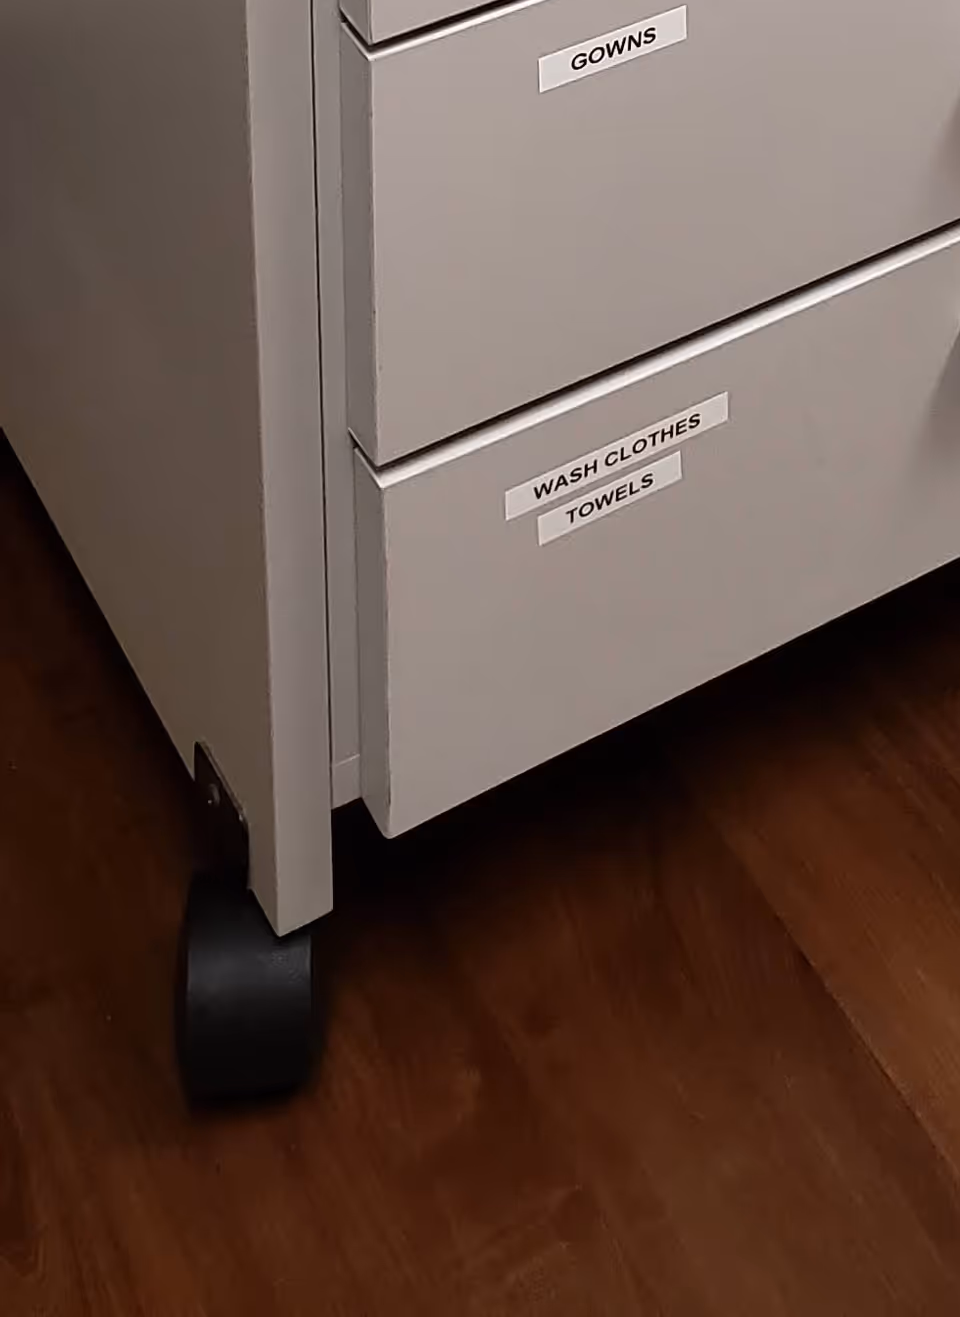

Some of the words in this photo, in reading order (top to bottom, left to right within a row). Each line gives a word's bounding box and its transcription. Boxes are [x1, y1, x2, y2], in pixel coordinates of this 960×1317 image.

[570, 26, 657, 71] GOWNS
[533, 458, 599, 500] WASH
[603, 412, 701, 467] CLOTHES
[565, 472, 655, 518] TOWELS
